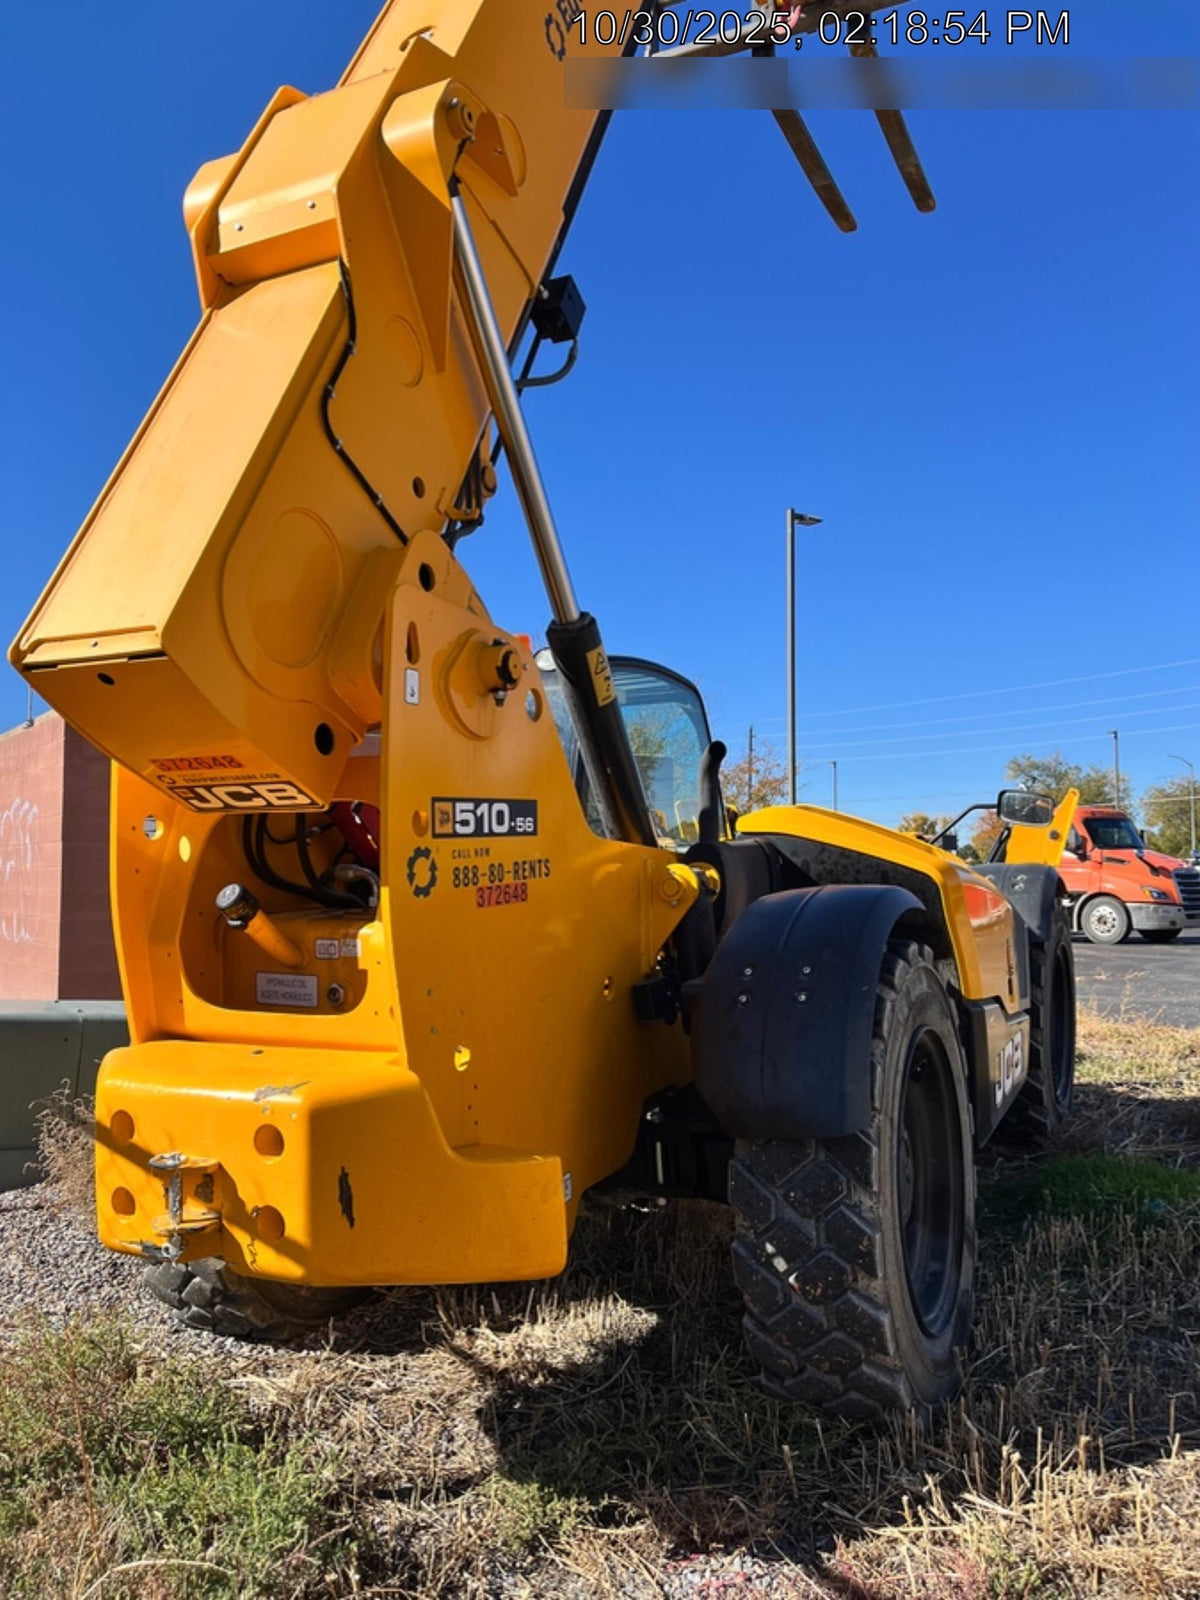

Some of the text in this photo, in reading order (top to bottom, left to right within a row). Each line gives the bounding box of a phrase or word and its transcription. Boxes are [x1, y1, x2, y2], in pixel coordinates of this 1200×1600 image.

[151, 755, 243, 772] 372648
[188, 783, 312, 809] JCB
[452, 848, 490, 859] CALL NOW
[452, 858, 551, 889] 888-80-RENTS
[477, 883, 528, 908] 372648
[995, 1030, 1022, 1108] JCB
